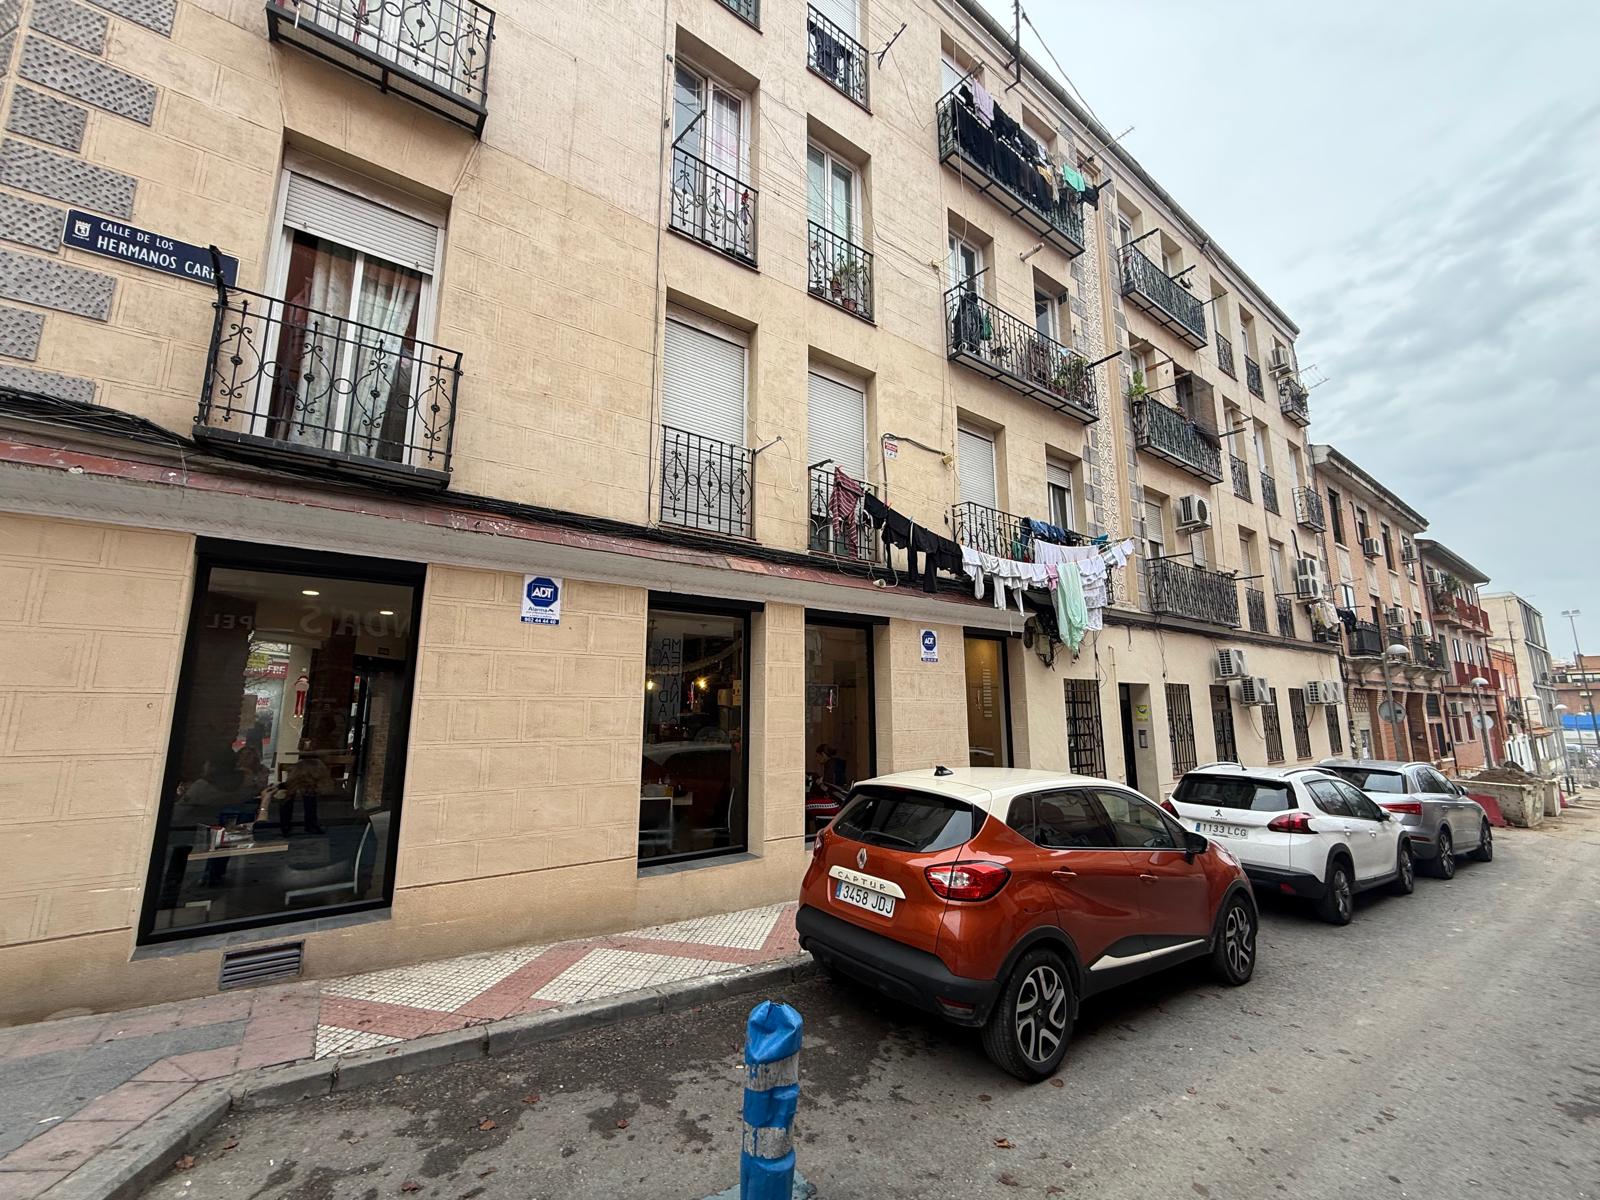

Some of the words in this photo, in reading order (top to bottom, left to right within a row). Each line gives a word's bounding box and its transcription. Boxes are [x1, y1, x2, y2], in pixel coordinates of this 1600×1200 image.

[100, 221, 131, 238] CALLE
[136, 232, 151, 244] DE
[156, 237, 174, 251] LOS
[97, 235, 177, 269] HERMANOS
[531, 587, 554, 598] ADT
[1203, 823, 1225, 834] 1133
[1227, 826, 1247, 837] LCG
[837, 871, 886, 891] CAPTUR
[843, 885, 869, 906] 3458
[871, 894, 894, 914] JDJ
